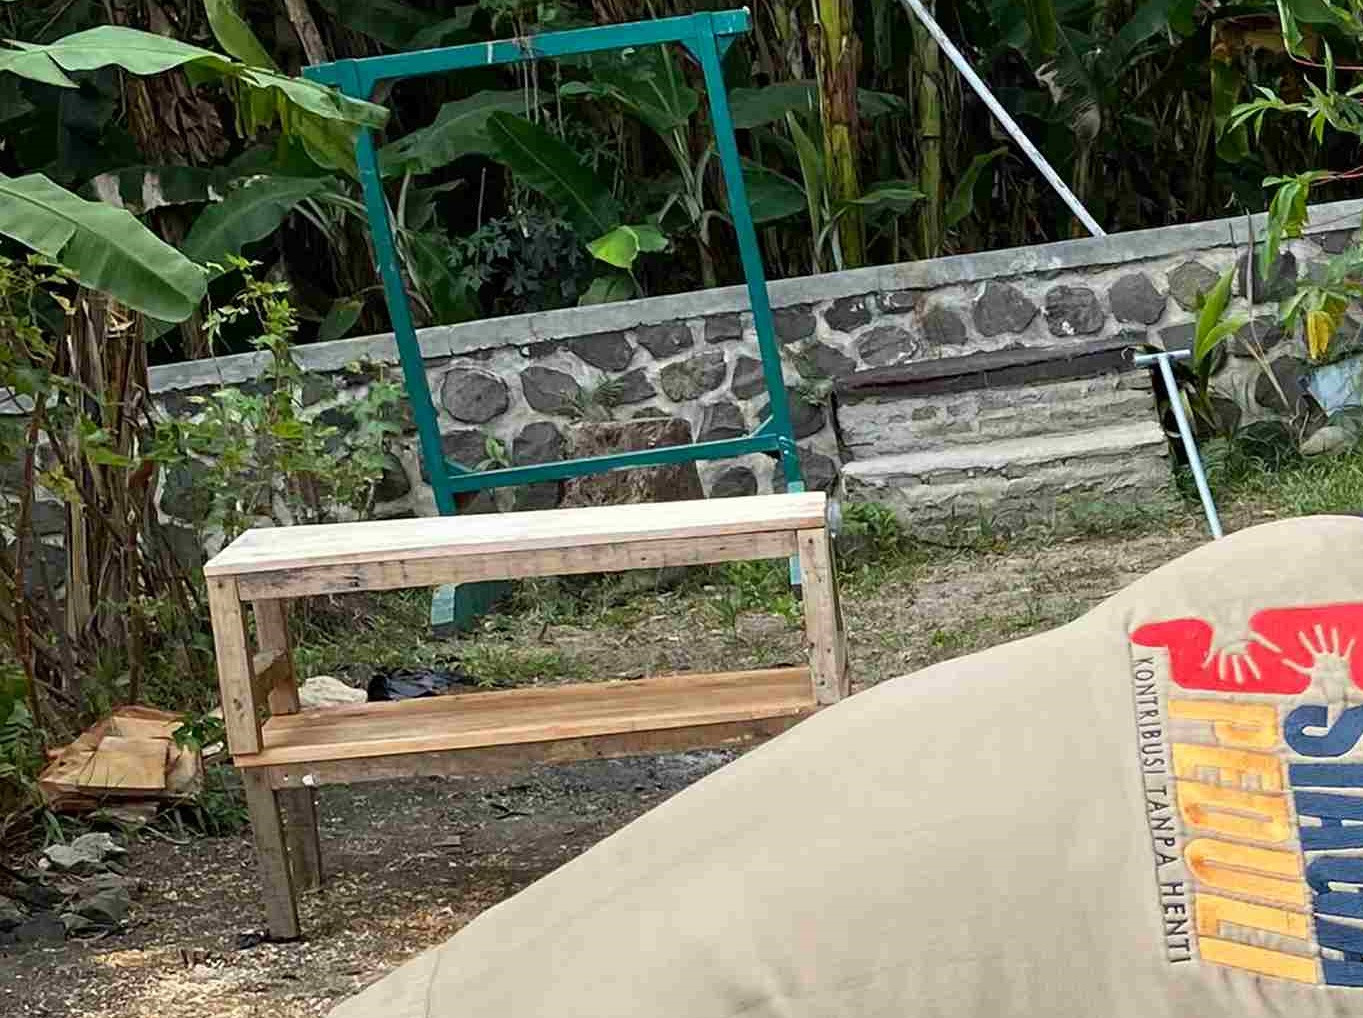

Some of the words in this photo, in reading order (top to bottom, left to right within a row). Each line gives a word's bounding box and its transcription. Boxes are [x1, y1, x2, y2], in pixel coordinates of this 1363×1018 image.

[1134, 656, 1166, 775] KONTRIBUSI
[1146, 784, 1178, 866] TANPA
[1167, 699, 1318, 984] PEDULI
[1160, 881, 1192, 963] HENTI
